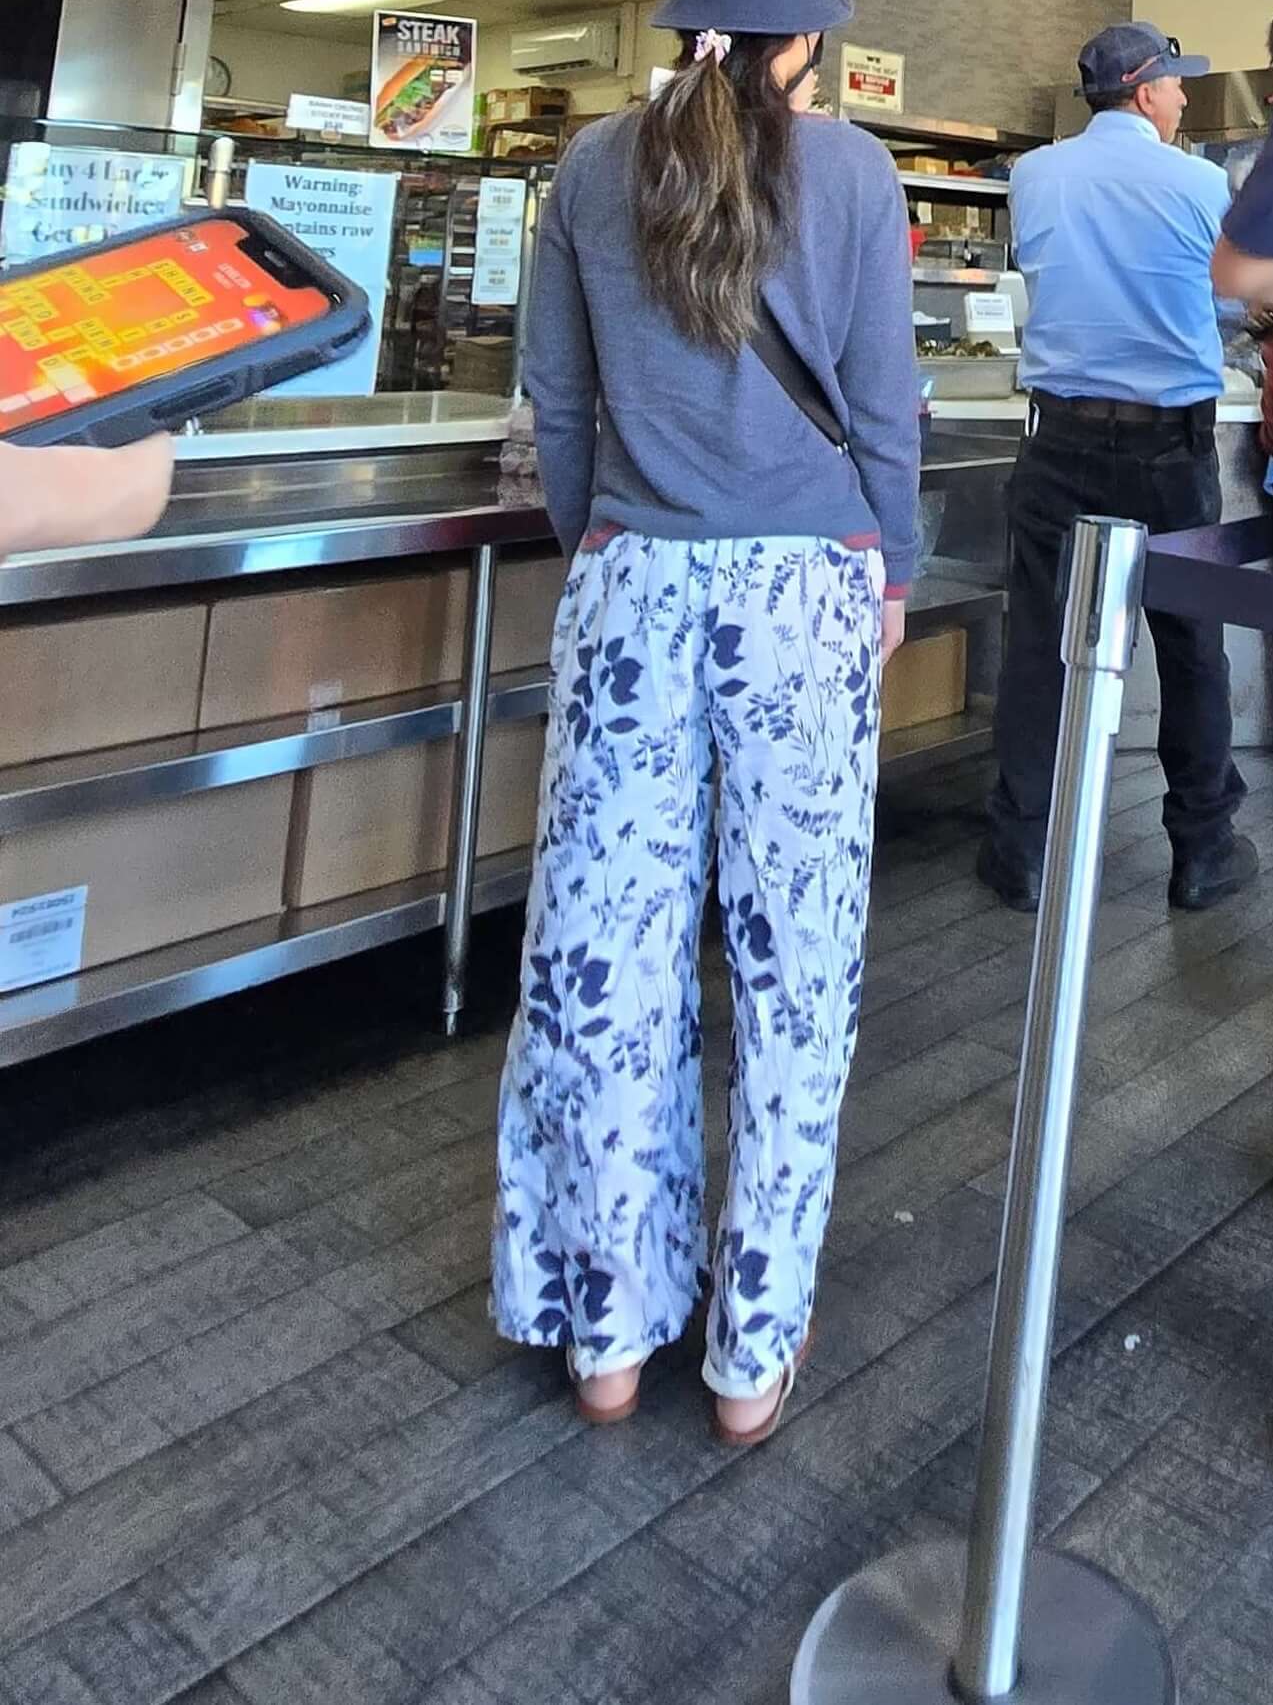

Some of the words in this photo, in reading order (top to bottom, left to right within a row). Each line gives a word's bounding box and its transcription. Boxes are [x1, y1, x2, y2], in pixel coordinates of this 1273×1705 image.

[398, 20, 460, 44] STEAK
[284, 175, 363, 197] Warning:
[270, 196, 373, 216] Mayonnaise
[342, 225, 374, 238] raw
